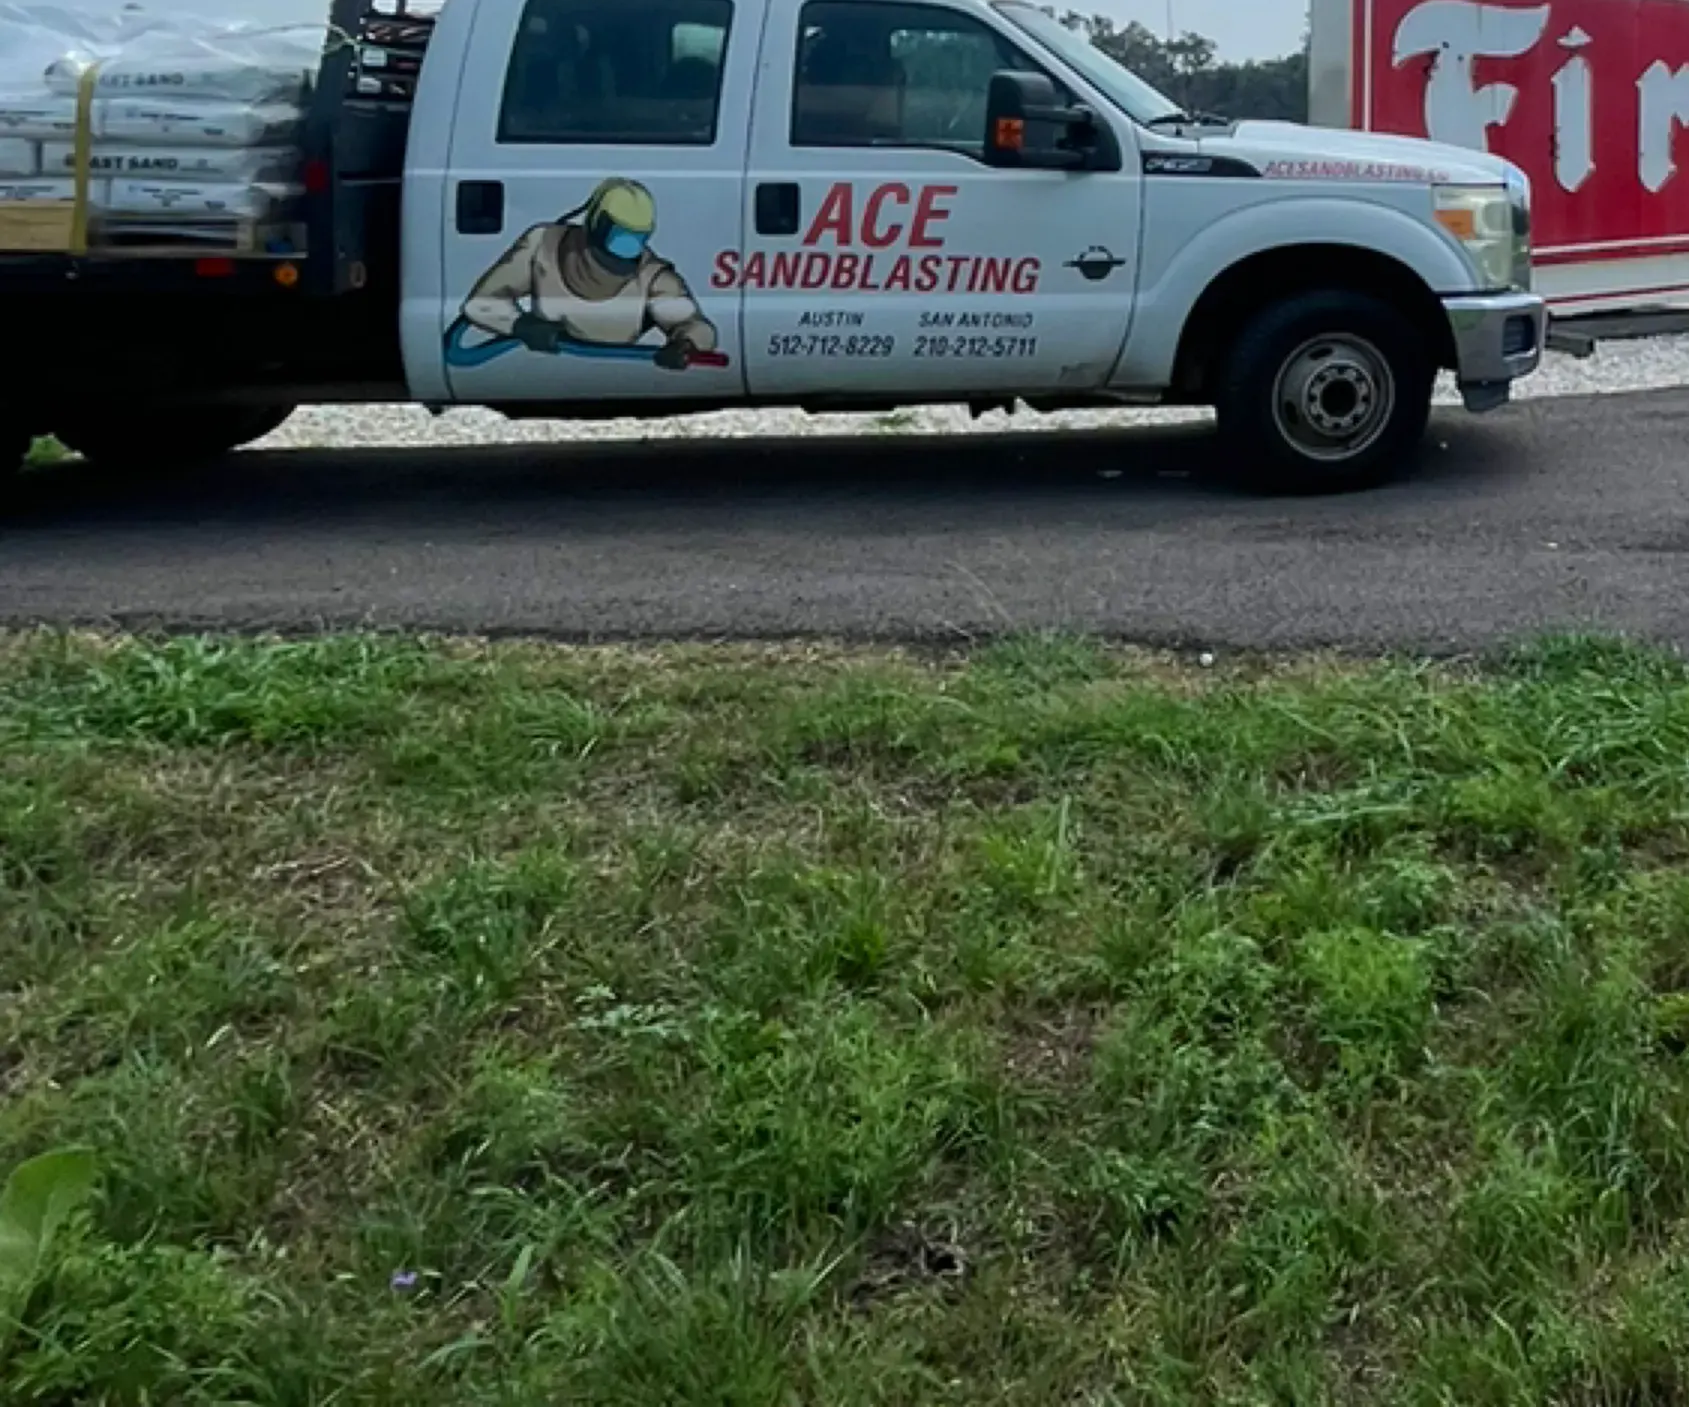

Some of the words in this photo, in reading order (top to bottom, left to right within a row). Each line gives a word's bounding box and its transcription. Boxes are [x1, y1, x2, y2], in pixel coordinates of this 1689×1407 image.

[800, 181, 958, 249] ACE
[710, 249, 1041, 294] SANDBLASTING
[798, 310, 865, 328] AUSTIN
[918, 311, 953, 328] SAN
[957, 311, 1034, 329] ANTONIO
[912, 334, 1038, 358] 210-212-5711
